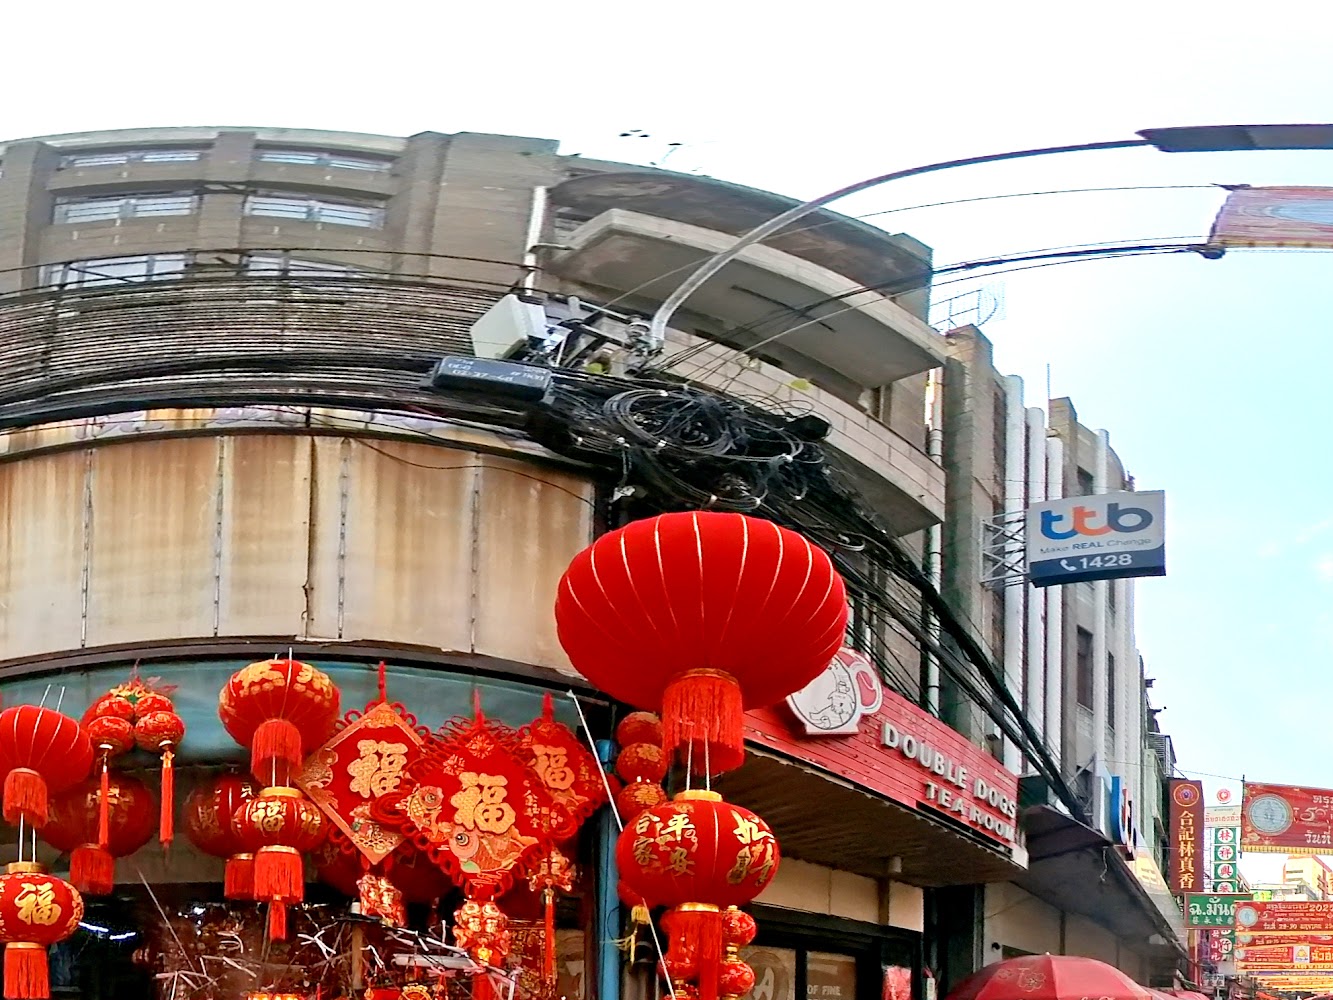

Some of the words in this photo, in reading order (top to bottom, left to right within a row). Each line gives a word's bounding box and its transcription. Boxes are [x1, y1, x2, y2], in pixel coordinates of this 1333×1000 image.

[1041, 503, 1153, 540] ttb
[1072, 542, 1104, 550] REAL
[1080, 553, 1132, 569] 1428
[347, 739, 408, 798] 福
[527, 743, 575, 790] 福
[881, 722, 967, 791] DOUBLE
[974, 776, 1017, 820] DOGS
[250, 799, 288, 832] 福
[450, 771, 517, 834] 福
[924, 780, 967, 814] TEA
[969, 805, 1016, 842] ROOM
[1177, 810, 1195, 890] 合記林真香
[14, 882, 62, 926] 福
[807, 984, 818, 995] OF
[821, 985, 841, 996] FINE
